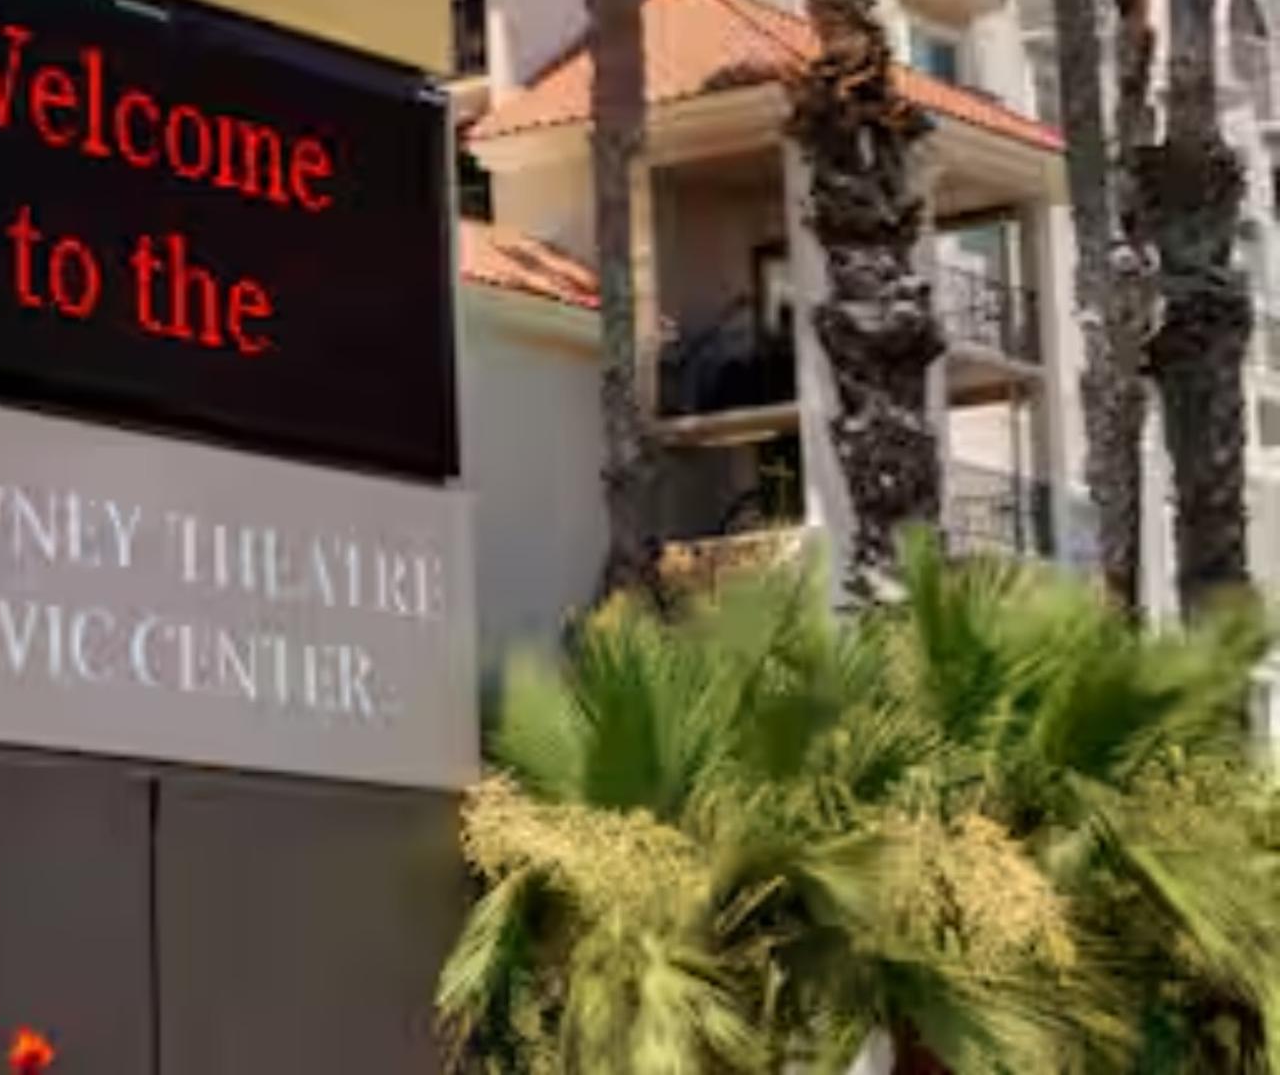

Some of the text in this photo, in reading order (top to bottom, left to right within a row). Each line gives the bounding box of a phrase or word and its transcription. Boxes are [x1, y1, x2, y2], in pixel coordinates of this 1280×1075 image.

[8, 206, 277, 355] to the
[166, 510, 443, 621] THEATRE
[129, 614, 378, 720] CENTER
